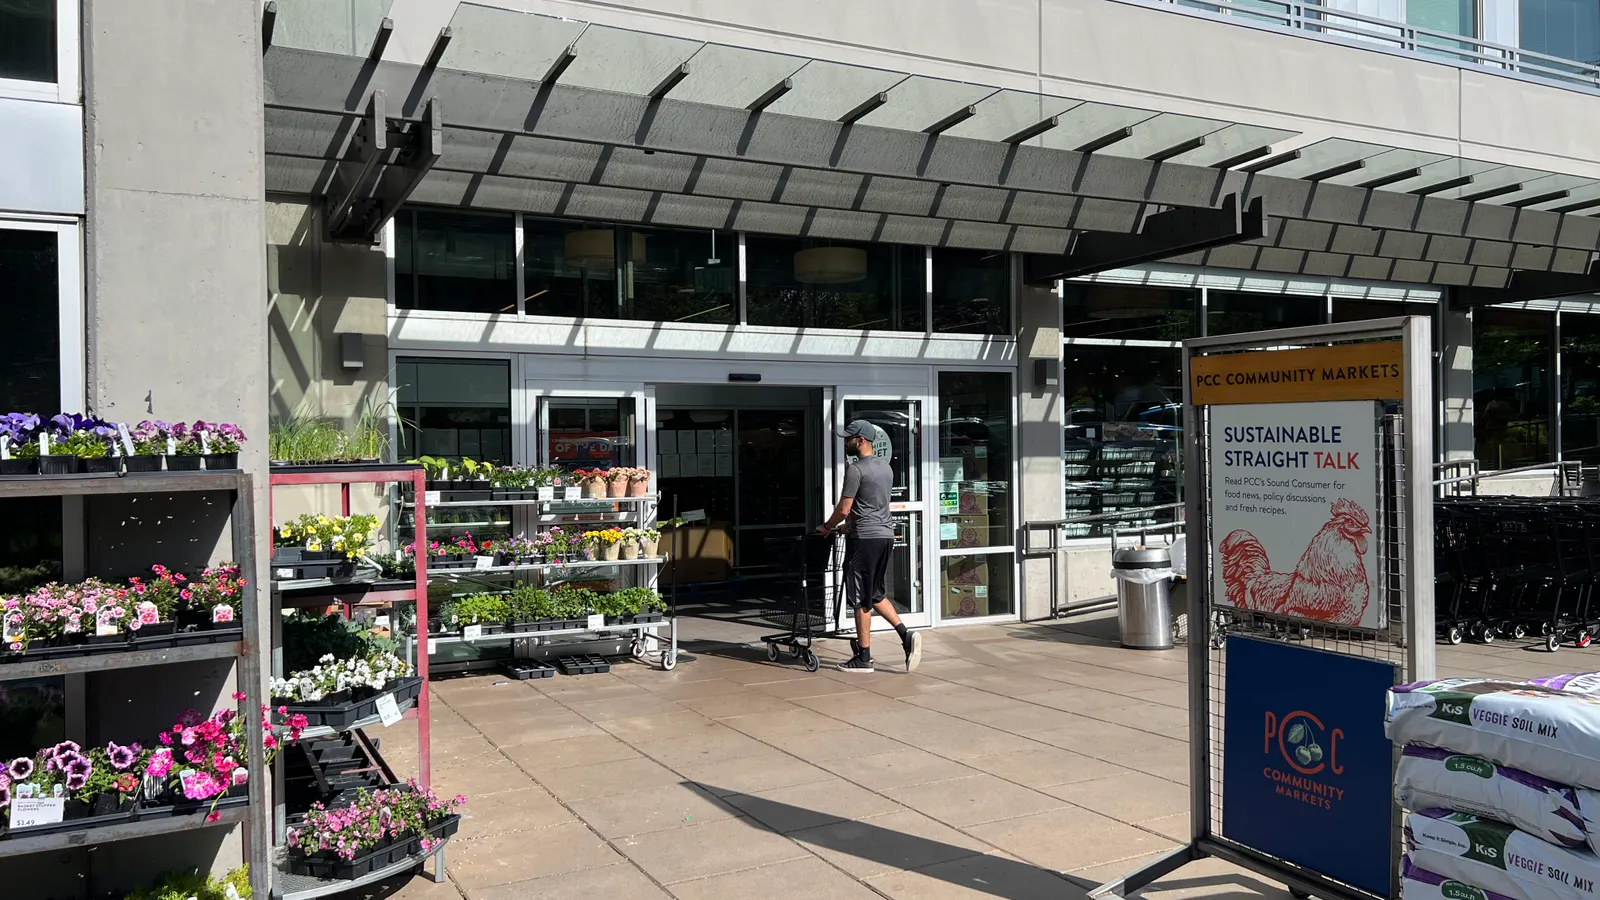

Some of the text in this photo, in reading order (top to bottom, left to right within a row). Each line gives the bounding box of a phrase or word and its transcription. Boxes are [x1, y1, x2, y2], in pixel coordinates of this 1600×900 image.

[1196, 363, 1400, 387] PCC COMMUNITY MARKETS
[1224, 426, 1342, 444] SUSTAINABLE
[555, 443, 571, 453] OF
[1224, 450, 1360, 470] STRAIGHT TALK
[1224, 476, 1346, 490] Read PCC's Sound Consumer for
[1224, 490, 1326, 503] food news, policy discussions
[1224, 503, 1287, 515] and fresh recipes.
[1473, 708, 1509, 727] VEGGIE
[1512, 717, 1533, 733] SOIL
[1537, 723, 1559, 739] MIX
[1264, 710, 1345, 775] PCC
[1454, 762, 1465, 770] 1.5
[1263, 767, 1345, 801] COMMUNITY
[1275, 784, 1332, 810] MARKETS
[1475, 843, 1594, 894] KiS VEGGIE SOIL MIX
